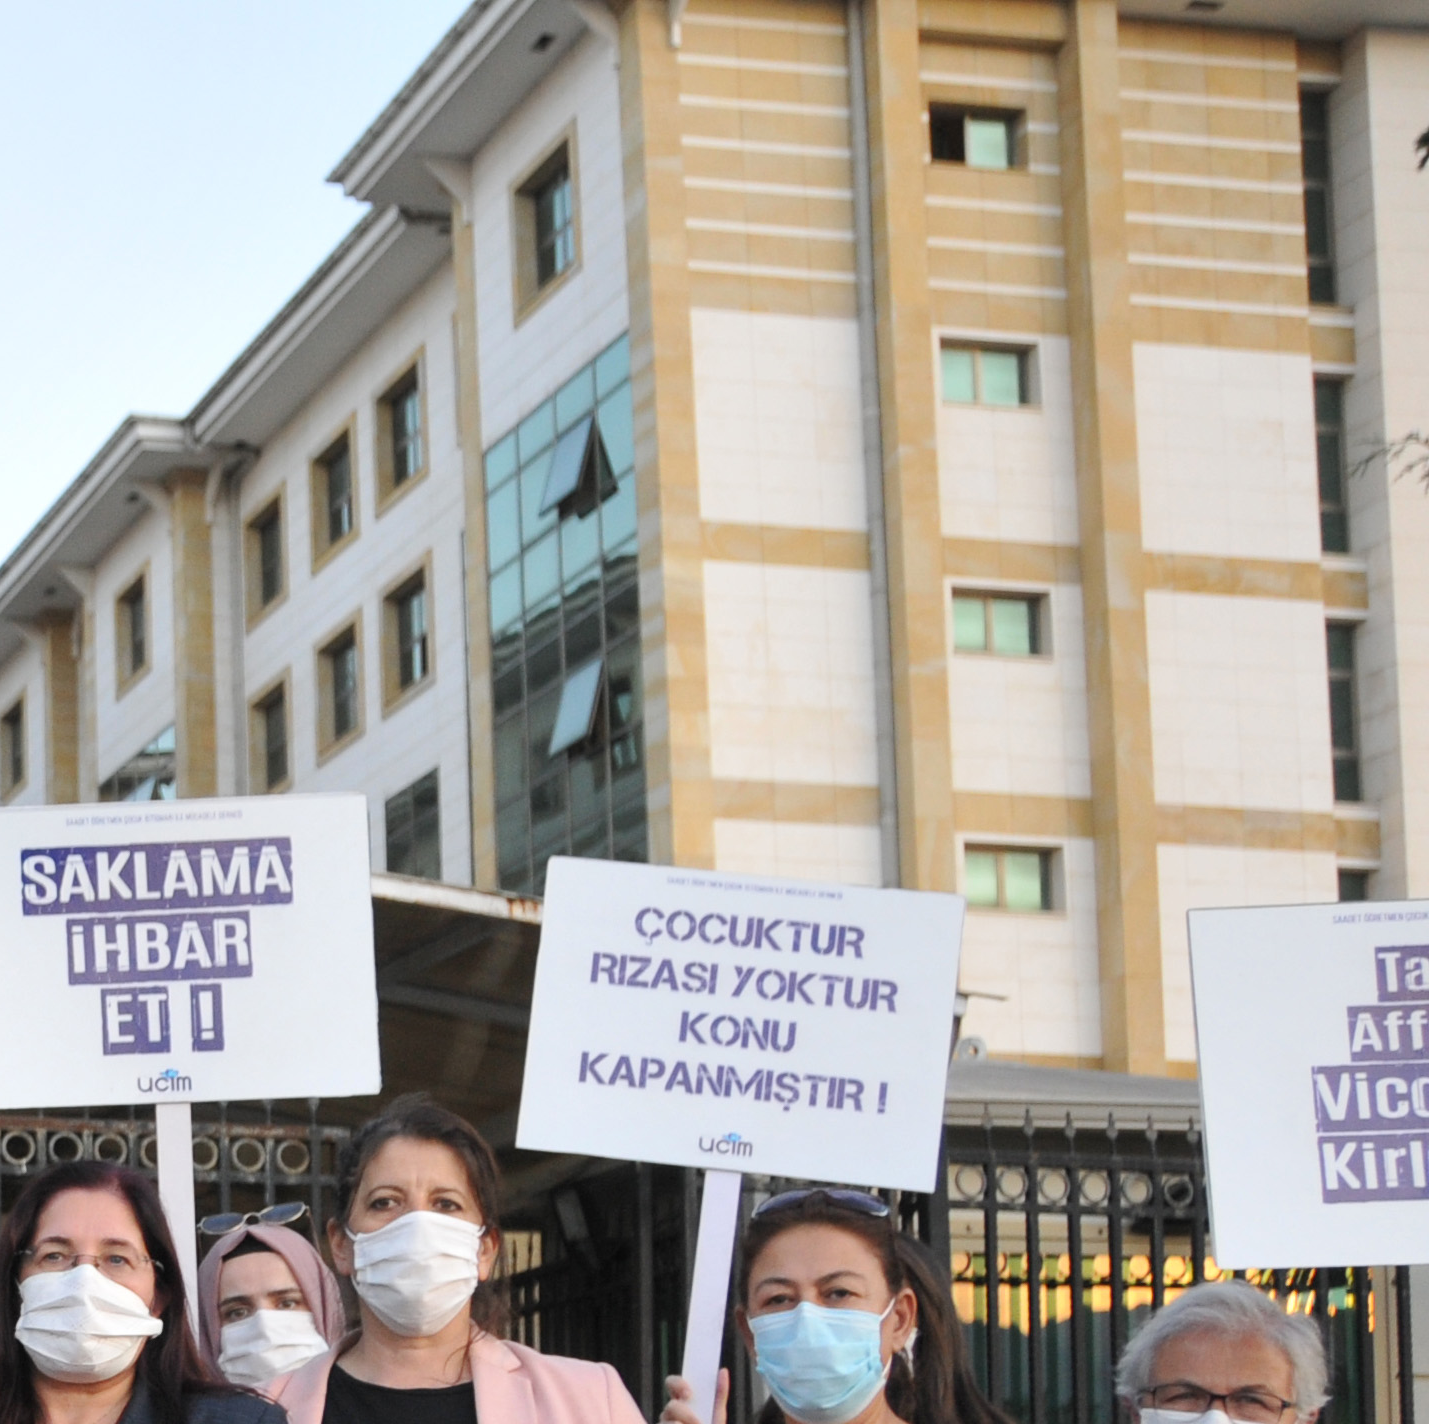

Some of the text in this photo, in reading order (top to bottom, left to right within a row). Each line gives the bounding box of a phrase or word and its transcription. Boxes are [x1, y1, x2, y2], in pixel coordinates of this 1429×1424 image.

[22, 845, 291, 905] SAKLAMA
[634, 906, 865, 959] ÇOCUKTUR
[590, 952, 899, 1013] RIZASI YOKTUR
[678, 1010, 797, 1054] KONU
[577, 1051, 865, 1112] KAPANMIŞTIR
